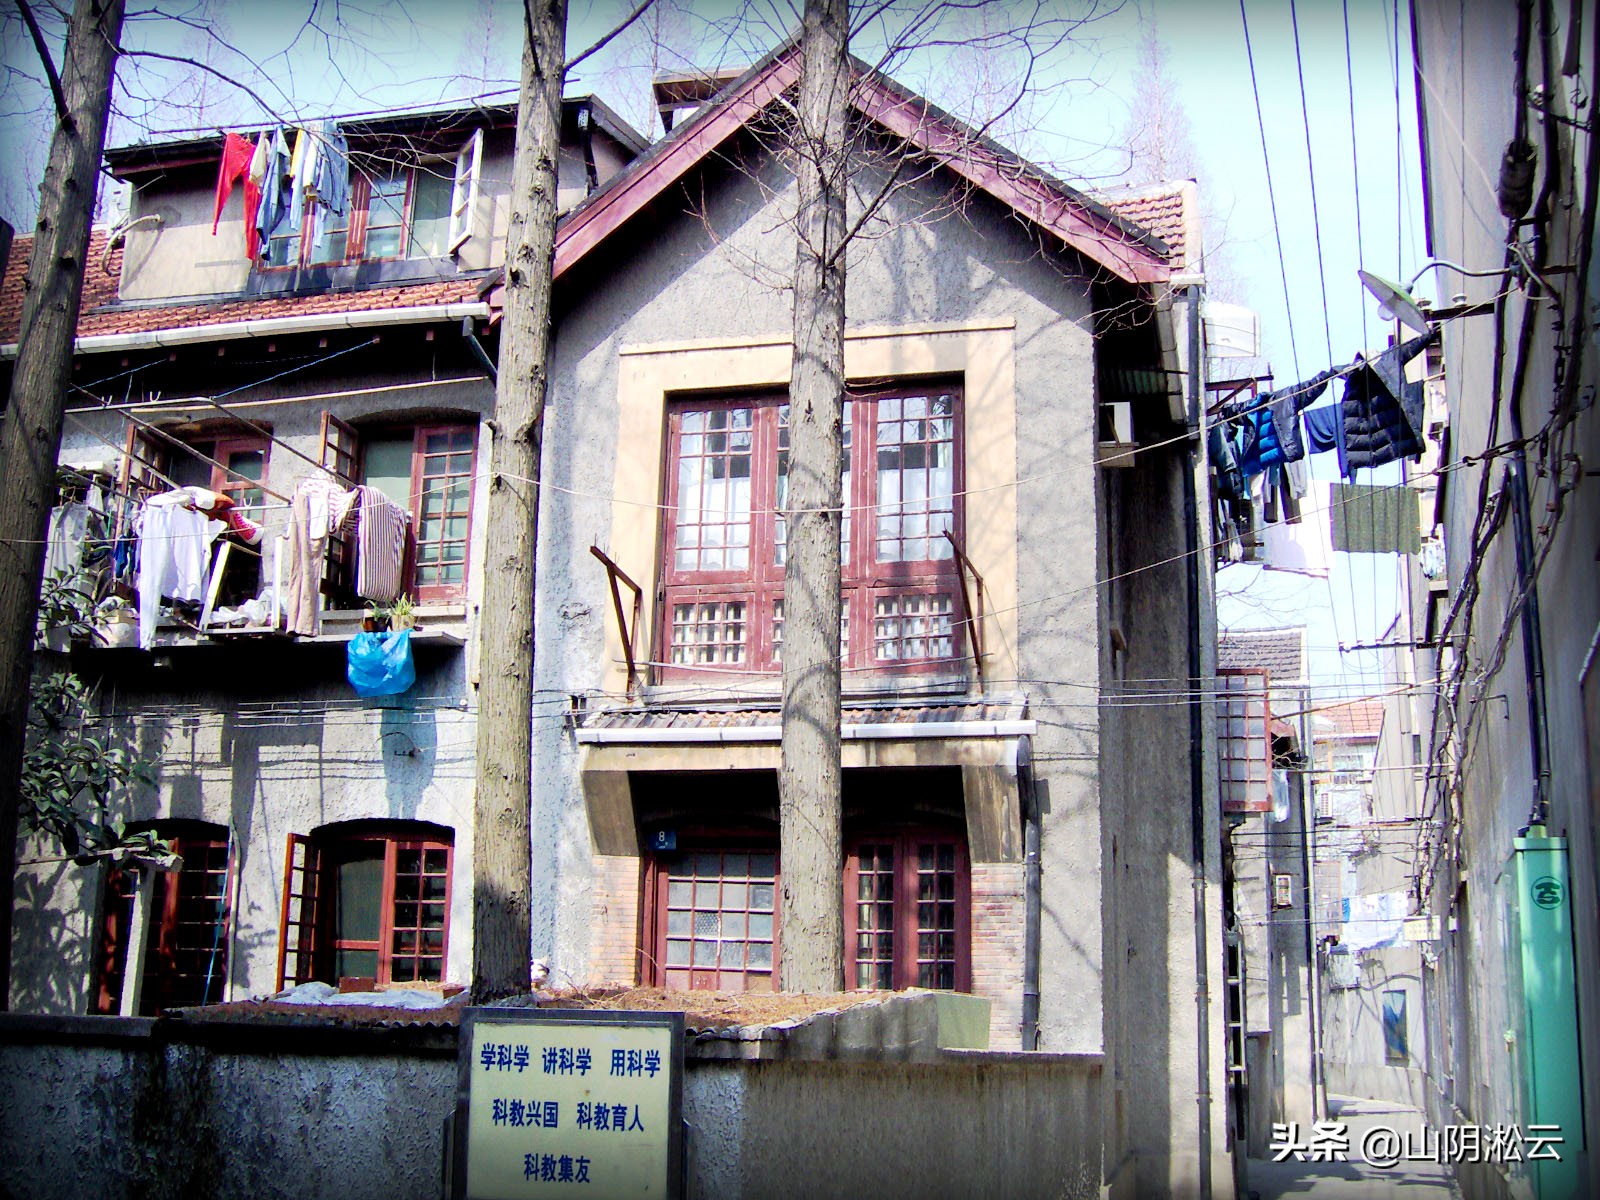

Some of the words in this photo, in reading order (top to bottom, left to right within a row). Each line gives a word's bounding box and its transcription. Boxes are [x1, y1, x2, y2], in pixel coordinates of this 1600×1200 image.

[658, 830, 665, 842] 8
[480, 1042, 530, 1073] 学科学
[542, 1047, 592, 1076] 讲科学
[610, 1049, 661, 1078] 用科学
[492, 1098, 559, 1129] 科教兴国
[576, 1101, 645, 1132] 科教育人
[524, 1153, 591, 1184] 科教集友
